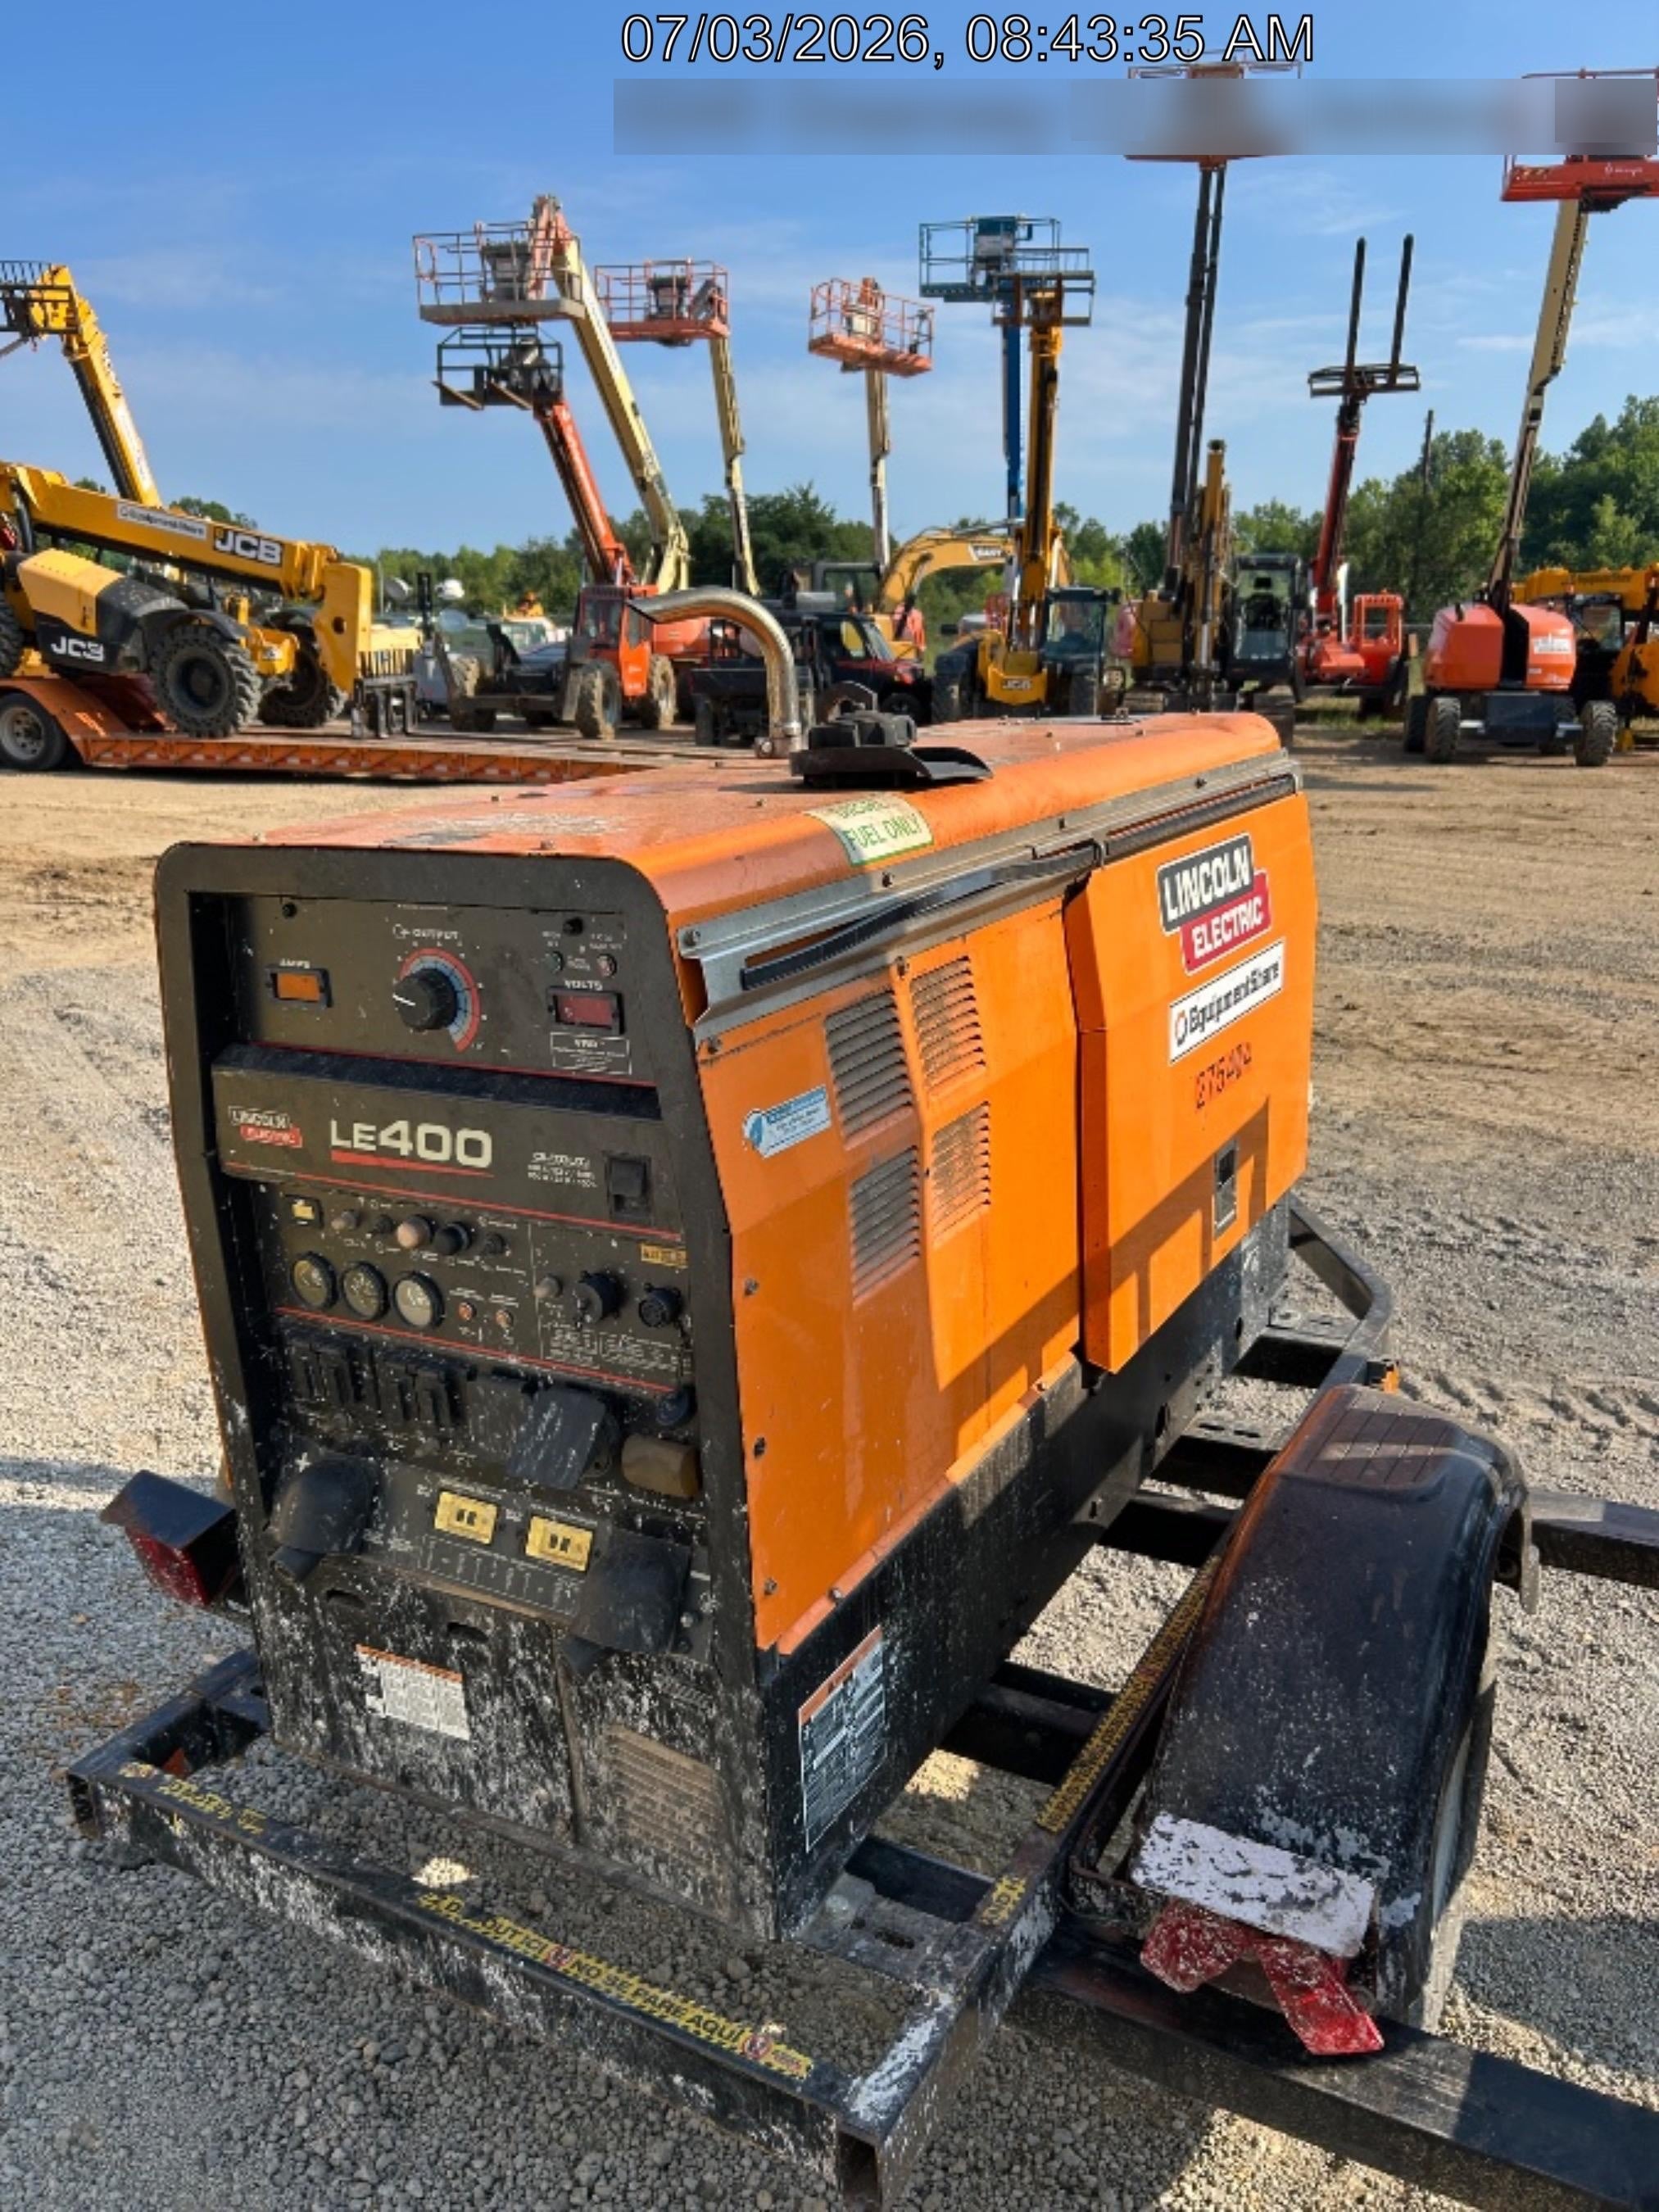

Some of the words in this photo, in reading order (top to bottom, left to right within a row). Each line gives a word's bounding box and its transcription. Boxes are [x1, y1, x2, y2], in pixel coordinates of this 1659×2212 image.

[214, 528, 283, 565] JCB
[50, 635, 105, 663] JCB
[841, 823, 886, 852] FUEL
[882, 812, 922, 840] ONLY
[1164, 845, 1251, 922] LINCOLN
[1191, 895, 1265, 959] ELECTRIC
[564, 979, 604, 991] VOLTS
[1190, 961, 1280, 1032] EquipmentShare
[231, 1108, 291, 1130] LINCOLN
[329, 1118, 493, 1169] LE400
[572, 1956, 604, 1980] NO
[605, 1972, 632, 1995] SE
[632, 1986, 689, 2018] PARE
